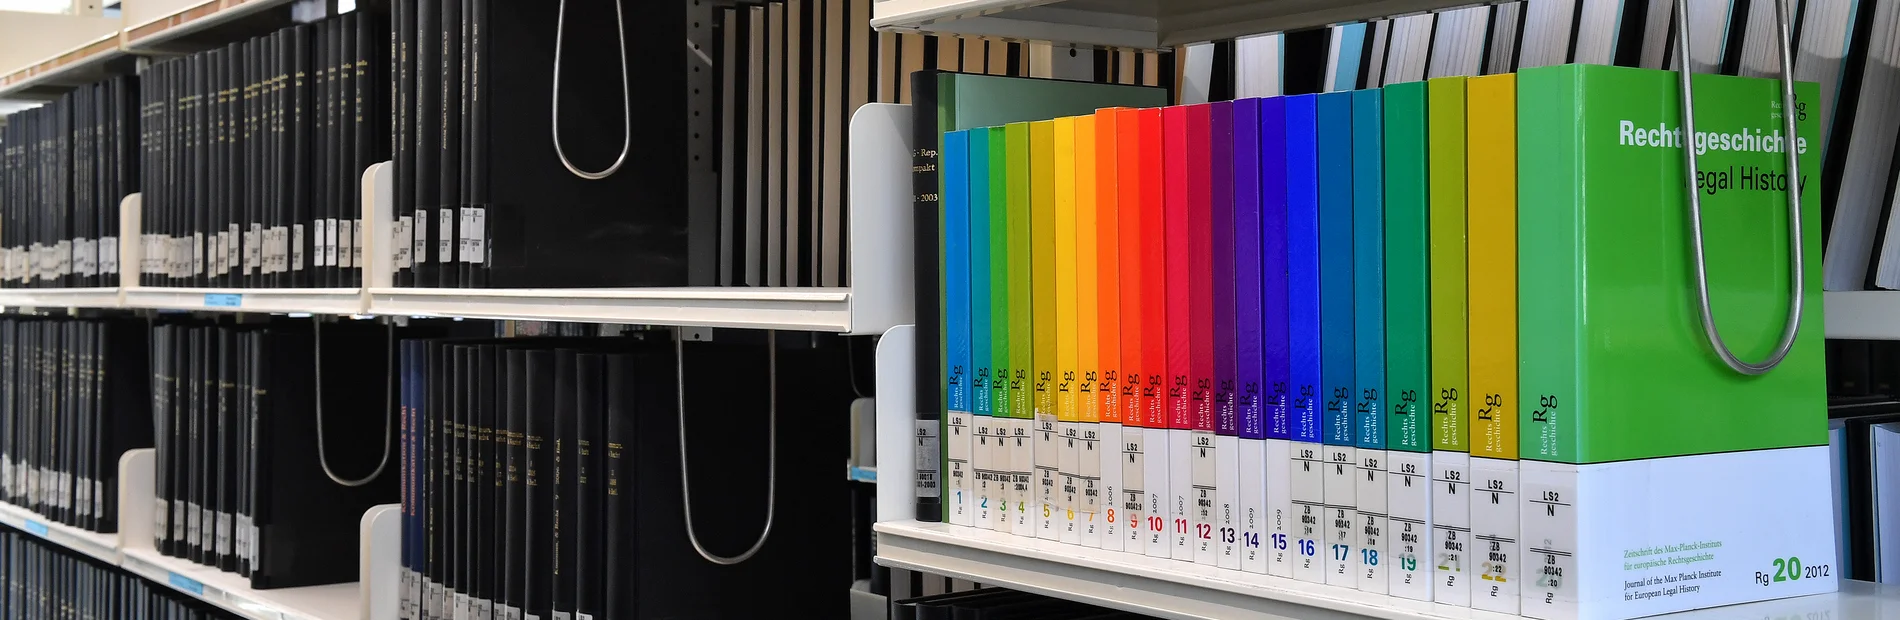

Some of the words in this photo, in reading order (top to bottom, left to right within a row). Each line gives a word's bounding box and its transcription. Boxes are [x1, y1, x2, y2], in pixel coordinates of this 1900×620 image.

[1620, 120, 1807, 155] Rechtgeschiche
[1684, 166, 1733, 195] egal
[1741, 166, 1807, 197] Histoy
[950, 365, 963, 385] Rg
[974, 367, 988, 388] Rg
[993, 369, 1008, 389] Rg
[1011, 369, 1026, 390] Rg
[1036, 371, 1051, 392] Rg
[1059, 371, 1075, 392] Rg
[1081, 371, 1097, 392] Rg
[1100, 370, 1117, 392] Rg
[1123, 374, 1140, 396] Rg
[1144, 375, 1162, 397] Rg
[1170, 376, 1188, 398] Rg
[1193, 378, 1210, 400] Rg
[1216, 380, 1234, 402] Rg
[1241, 382, 1258, 405] Rg
[1268, 382, 1286, 405] Rg
[1295, 384, 1314, 408] Rg
[1328, 386, 1348, 412] Rg
[1358, 388, 1378, 414] Rg
[1434, 388, 1458, 415] Rg
[1394, 390, 1416, 416] Rg
[1478, 393, 1502, 422] Rg
[1532, 394, 1558, 424] Rg
[955, 427, 960, 435] N
[1066, 428, 1076, 436] LS2
[1450, 403, 1458, 446] geschichte
[1494, 409, 1502, 453] geschichte
[918, 438, 924, 446] N
[1198, 437, 1208, 446] LS2
[1549, 412, 1558, 456] geschichte
[1127, 443, 1137, 451] LS2
[1200, 448, 1206, 458] N
[1301, 450, 1313, 458] LS2
[1333, 452, 1346, 462] LS2
[1365, 458, 1378, 468] LS2
[1304, 462, 1310, 472] N
[1337, 465, 1342, 475] N
[1402, 463, 1415, 473] LS2
[1445, 470, 1460, 480] LS2
[1368, 471, 1374, 482] N
[1405, 476, 1411, 487] N
[1449, 484, 1456, 494] N
[1488, 480, 1503, 490] LS2
[981, 495, 988, 508] 2
[1492, 493, 1498, 504] N
[1544, 491, 1558, 502] LS2
[1000, 499, 1006, 511] 3
[1018, 502, 1024, 513] 4
[1044, 504, 1050, 518] 5
[1548, 505, 1554, 516] N
[1108, 509, 1114, 522] 8
[1148, 516, 1162, 532] 10
[1175, 518, 1186, 534] 11
[1196, 524, 1211, 540] 12
[1404, 523, 1412, 532] ZB
[1220, 527, 1235, 543] 13
[1244, 532, 1259, 548] 14
[1272, 534, 1286, 550] 15
[1402, 533, 1417, 543] 90342
[1448, 531, 1456, 540] ZB
[1298, 539, 1314, 556] 16
[1332, 544, 1348, 560] 17
[1444, 541, 1462, 552] 90342
[1492, 542, 1500, 551] ZB
[1624, 547, 1652, 558] Zeitschrift
[1654, 546, 1663, 554] des
[1664, 540, 1722, 554] Max-Planck-Instituts
[1362, 548, 1378, 566] 18
[1399, 554, 1416, 571] 19
[1489, 552, 1506, 562] 90342
[1547, 555, 1556, 564] ZB
[1668, 552, 1714, 564] Rechtsgeschichte
[1405, 574, 1412, 584] Rg
[1544, 566, 1562, 576] 90342
[1756, 572, 1769, 586] Rg
[1773, 556, 1802, 582] 20
[1805, 564, 1829, 578] 2012
[1447, 576, 1455, 586] Rg
[1624, 578, 1645, 590] Journal
[1646, 576, 1654, 586] of
[1654, 576, 1662, 584] the
[1664, 574, 1678, 584] Max
[1679, 572, 1697, 582] Planck
[1698, 570, 1722, 578] Institute
[1491, 586, 1499, 597] Rg
[1546, 592, 1554, 604] Rg
[1625, 592, 1633, 601] for
[1634, 590, 1662, 600] European
[1663, 586, 1678, 596] Legal
[1679, 585, 1700, 594] History
